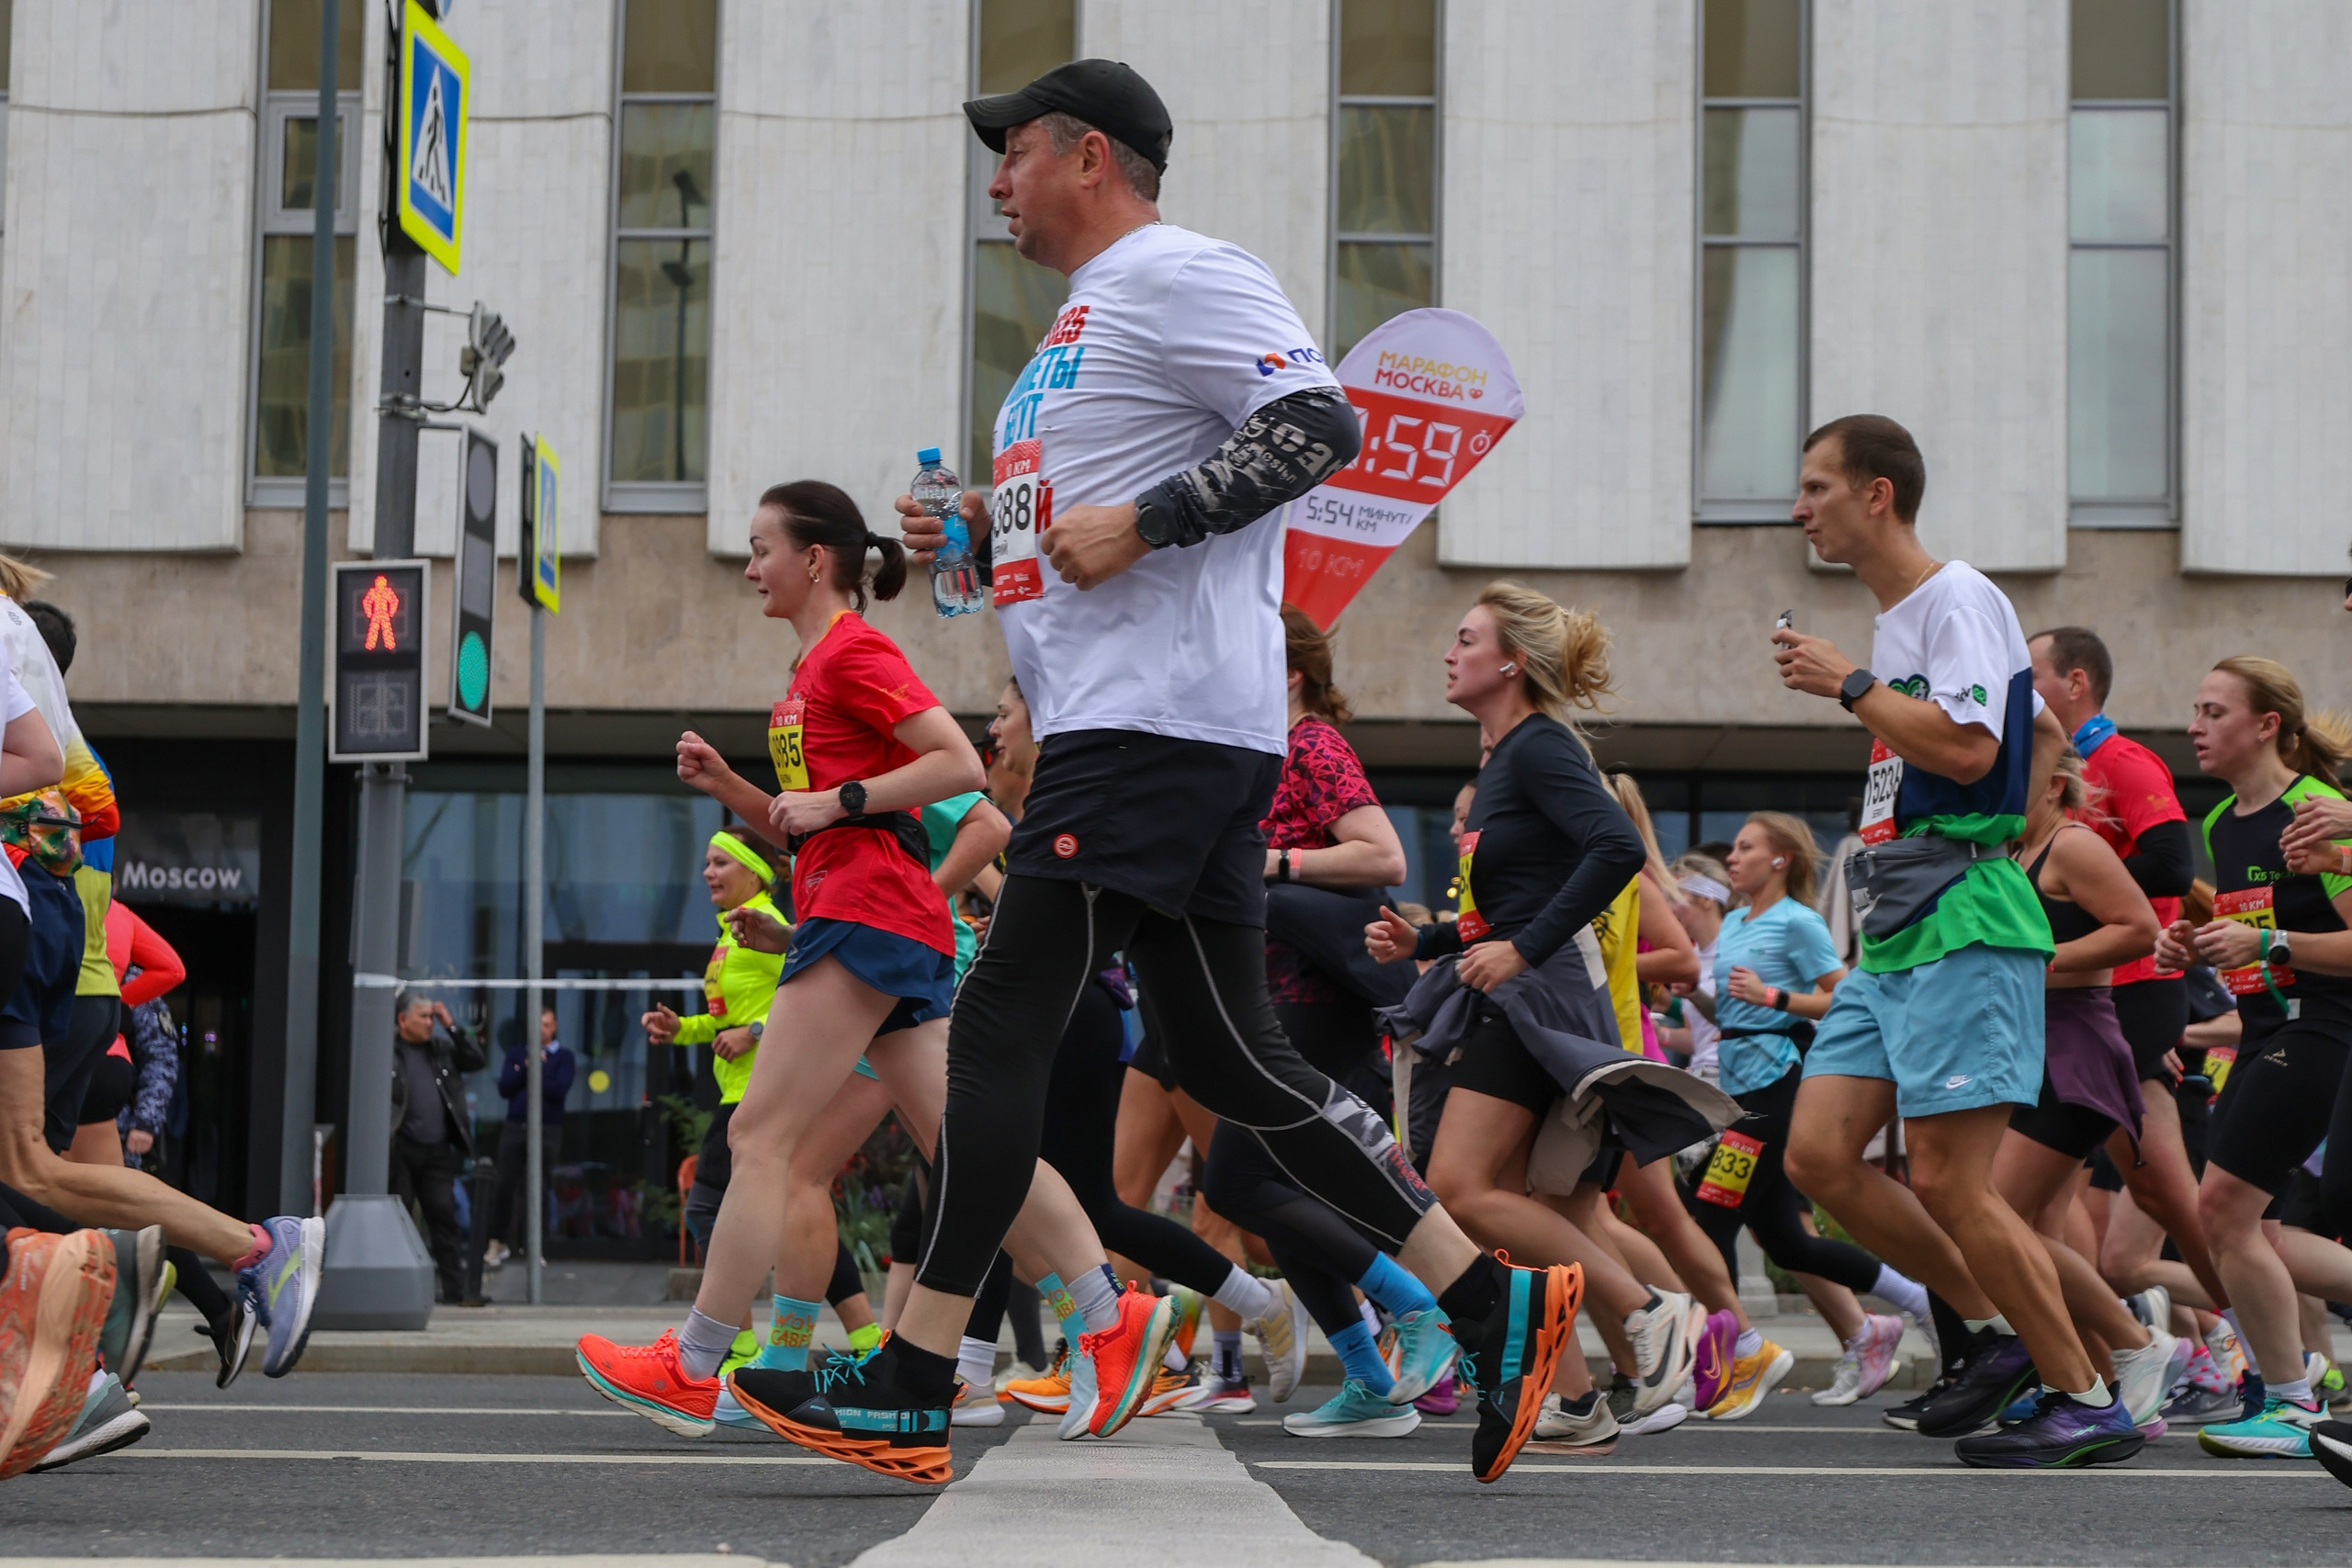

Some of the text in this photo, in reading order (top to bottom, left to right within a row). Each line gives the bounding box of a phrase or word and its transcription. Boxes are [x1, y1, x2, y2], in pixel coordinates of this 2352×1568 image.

[1374, 368, 1464, 400] МОСКВА
[1378, 350, 1488, 387] МАРАФОН
[991, 482, 1031, 538] 388
[1306, 495, 1354, 526] 5:54
[1297, 547, 1322, 571] 10
[121, 861, 242, 890] Moscow
